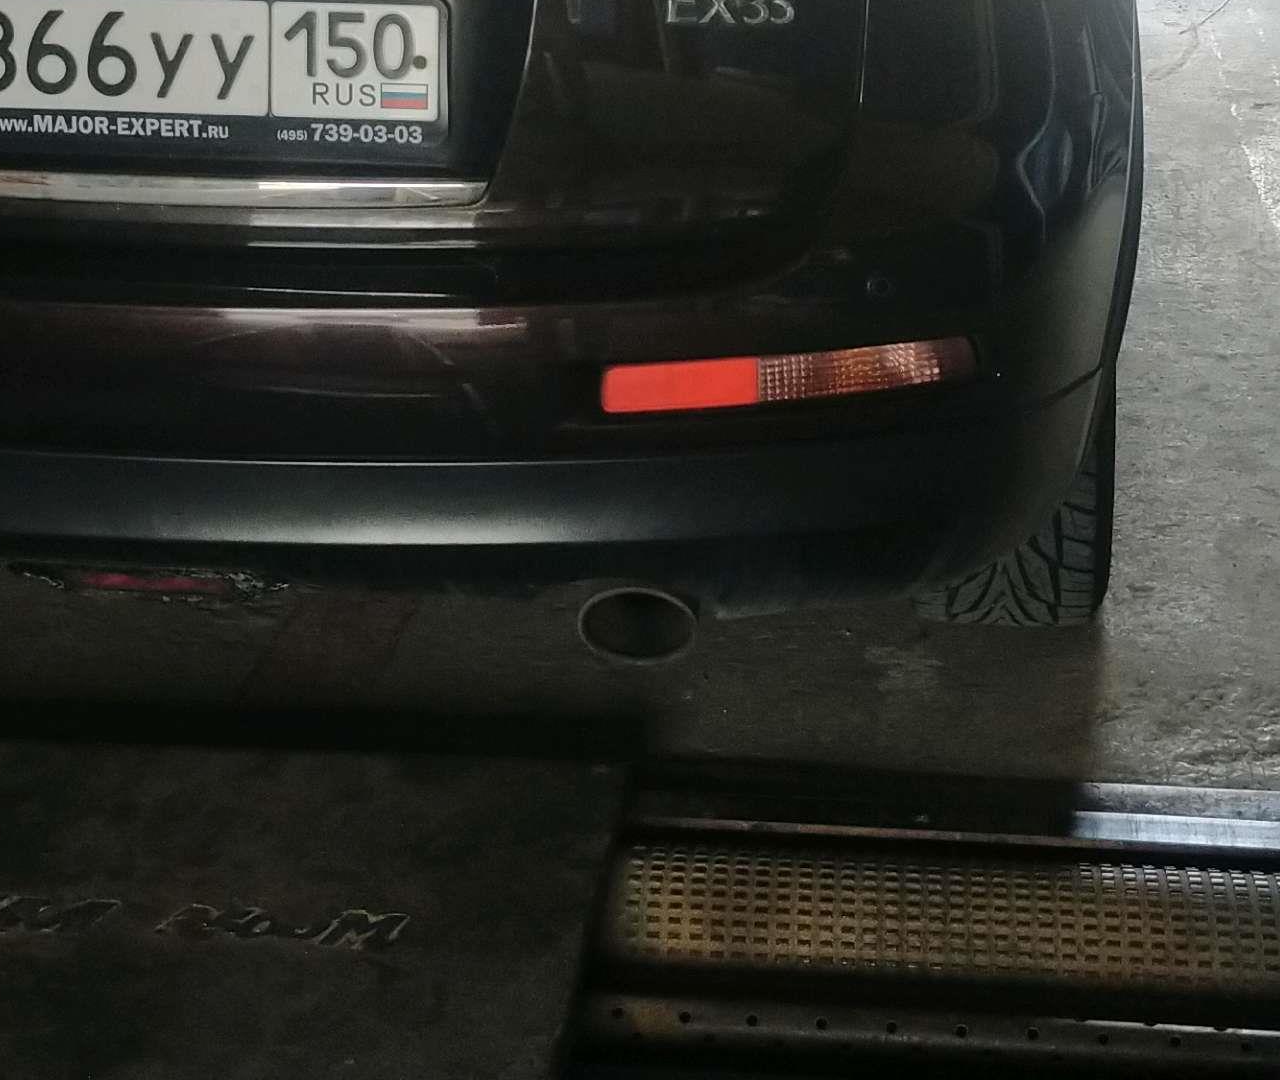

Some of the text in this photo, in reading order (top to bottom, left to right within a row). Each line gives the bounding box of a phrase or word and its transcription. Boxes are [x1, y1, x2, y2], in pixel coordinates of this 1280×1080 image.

[284, 11, 416, 80] 150
[312, 82, 377, 107] RUS
[276, 123, 423, 144] (495) 739-03-03
